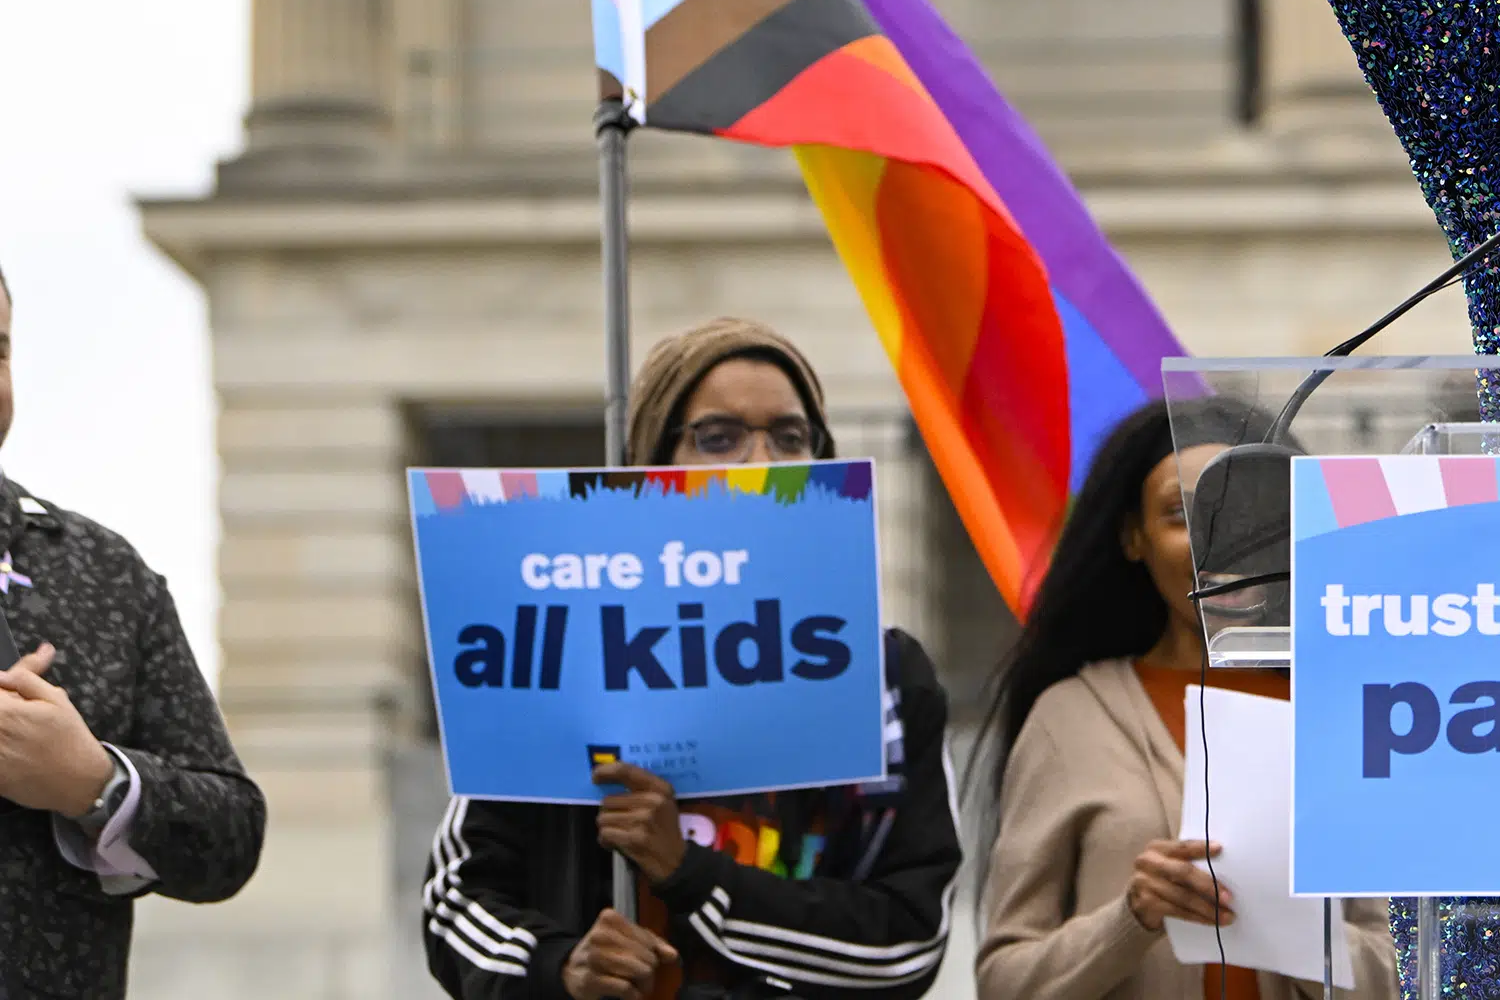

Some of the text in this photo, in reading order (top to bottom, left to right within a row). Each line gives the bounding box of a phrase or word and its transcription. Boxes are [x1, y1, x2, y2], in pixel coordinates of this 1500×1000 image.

[521, 541, 749, 590] care for
[453, 597, 853, 692] all kids
